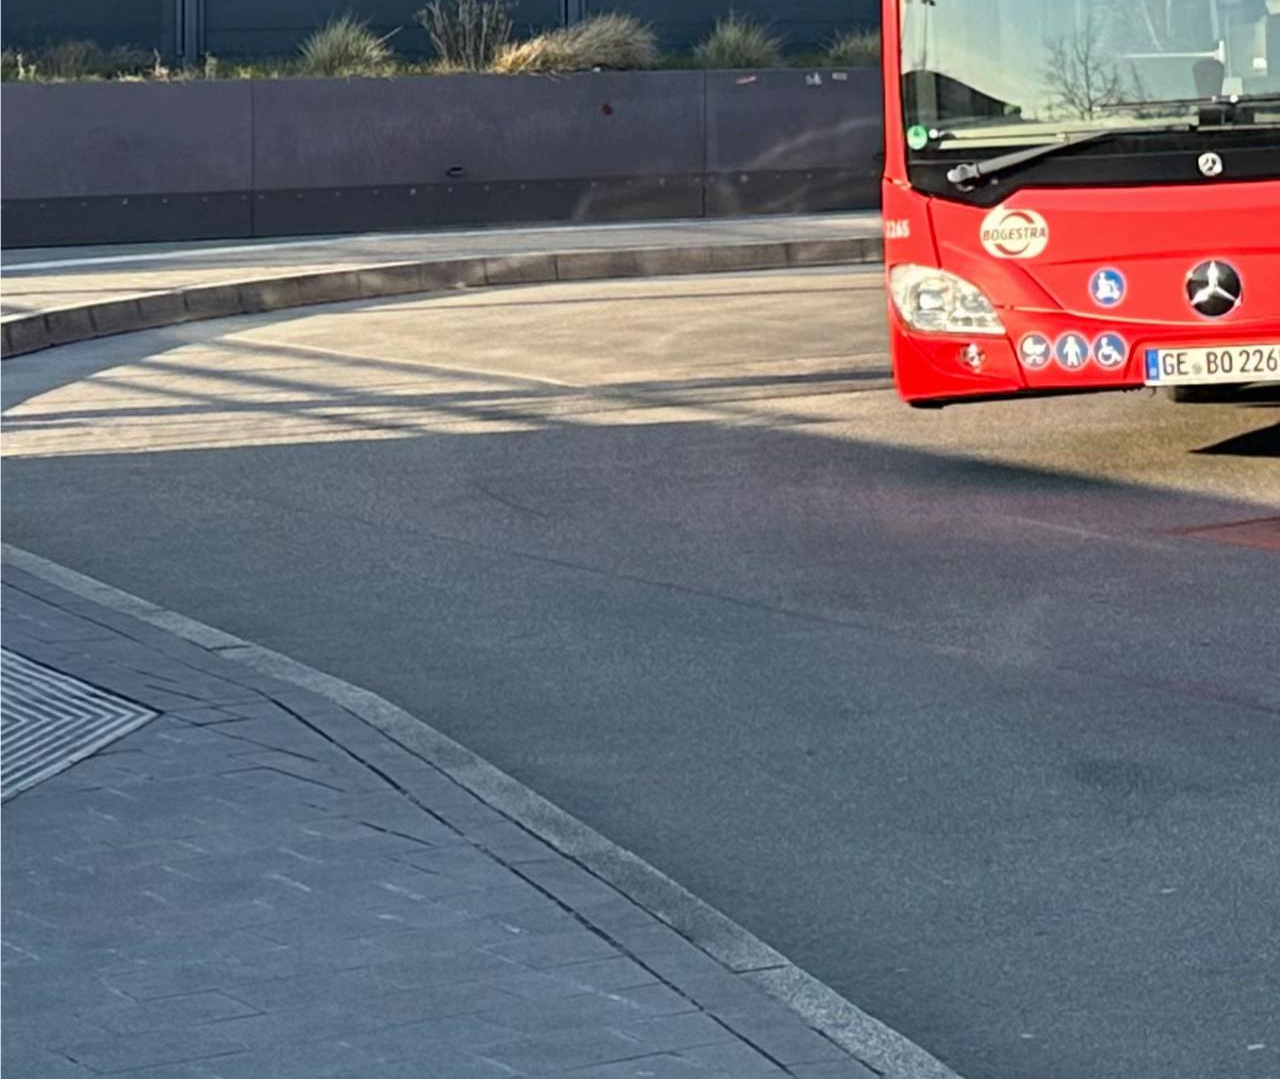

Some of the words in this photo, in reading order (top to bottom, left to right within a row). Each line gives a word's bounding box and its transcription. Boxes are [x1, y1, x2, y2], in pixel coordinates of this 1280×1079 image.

[982, 226, 1047, 242] BOGESTRA
[1162, 352, 1189, 375] GE
[1206, 350, 1233, 374] BO
